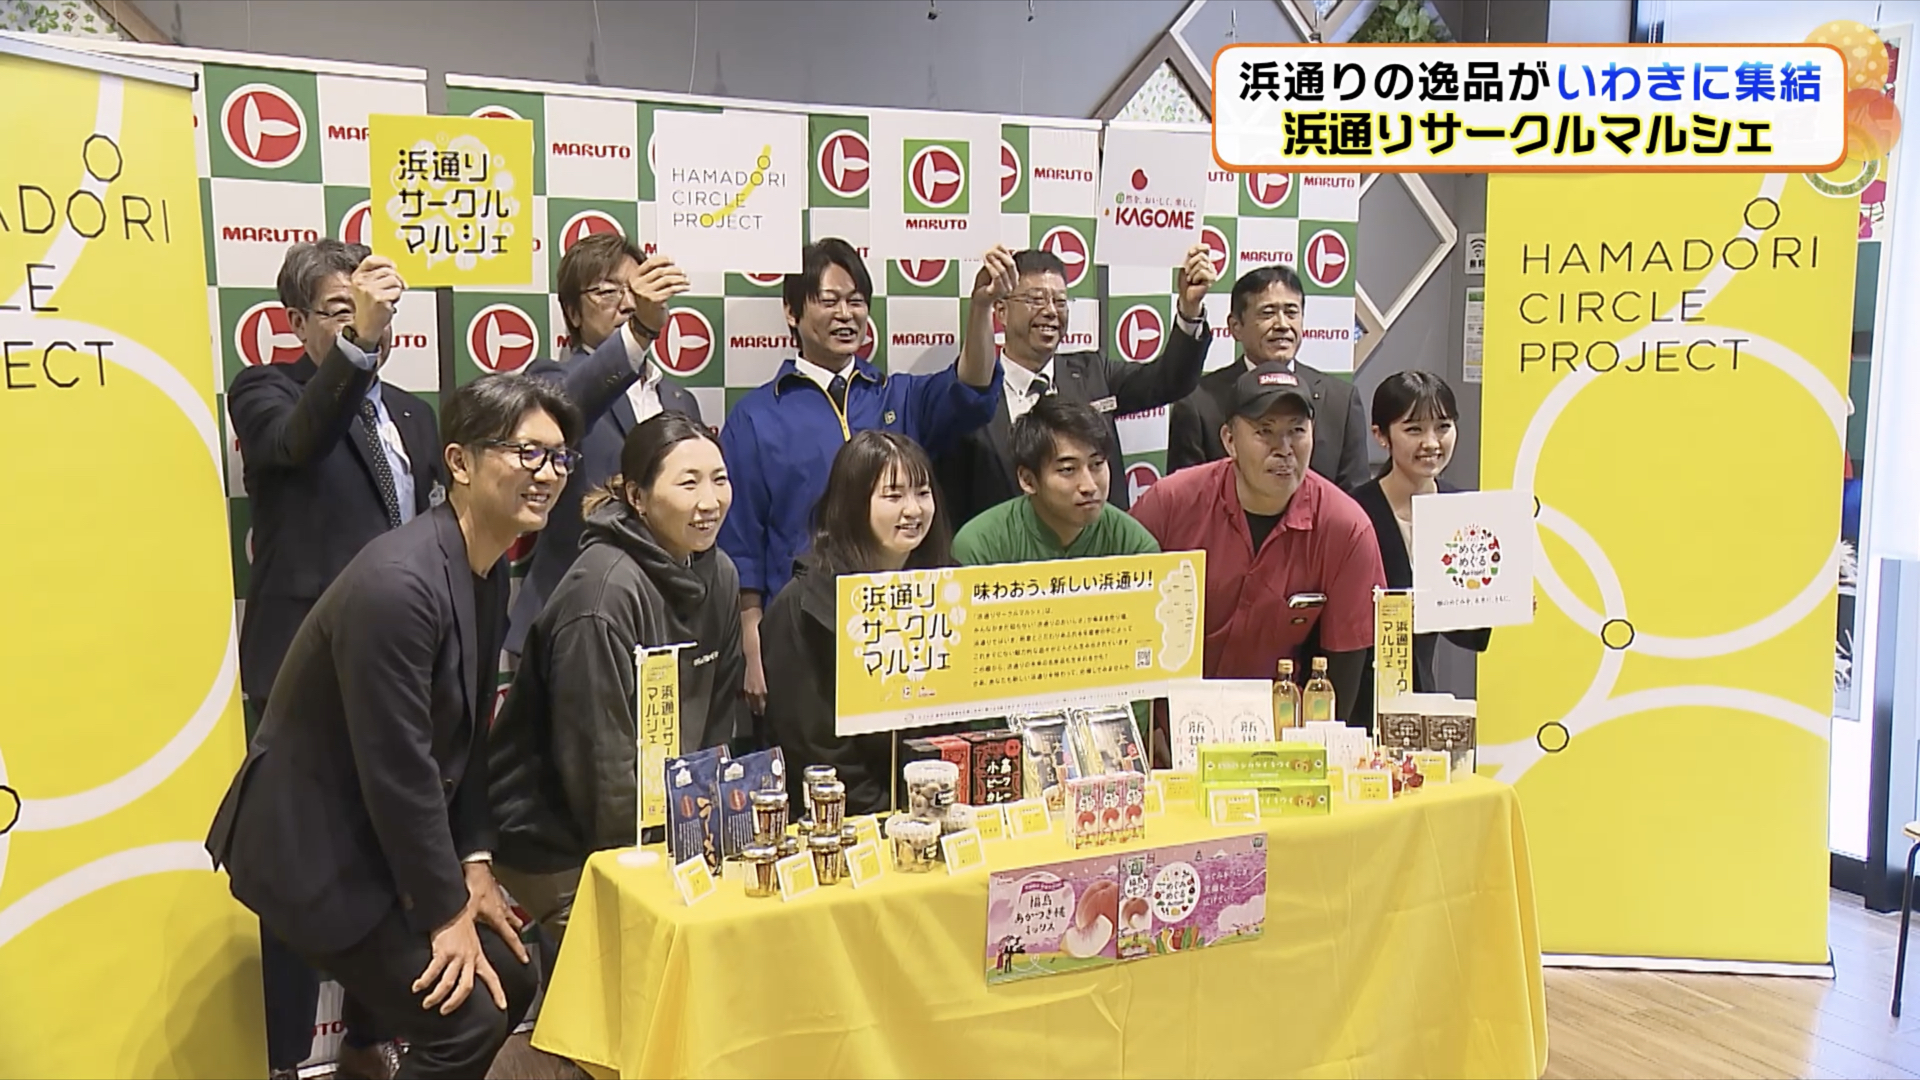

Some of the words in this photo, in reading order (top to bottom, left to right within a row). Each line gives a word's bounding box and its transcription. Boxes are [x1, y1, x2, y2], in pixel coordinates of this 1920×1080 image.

[552, 142, 631, 159] MARUTO
[397, 149, 488, 182] 浜通り
[672, 167, 786, 188] HAMADORI
[1034, 167, 1093, 182] MARUTO
[1303, 175, 1355, 189] MARUTO
[399, 189, 510, 219] サークル
[672, 191, 746, 208] CIRCLE
[0, 185, 170, 245] DORI
[673, 212, 763, 230] PROJECT
[905, 219, 968, 231] MARUTO
[1115, 206, 1195, 230] KAGOME
[222, 226, 318, 243] MARUTO
[400, 224, 508, 254] マルシェ
[1240, 251, 1293, 263] MARUTO
[1522, 235, 1819, 276] HAMADORI
[1519, 289, 1707, 325] CIRCLE
[892, 333, 955, 346] MARUTO
[1520, 338, 1750, 373] PROJECT
[862, 582, 937, 613] 浜通り
[862, 612, 953, 647] サークル
[862, 644, 951, 677] マルシェ
[645, 686, 660, 744] マルシェ
